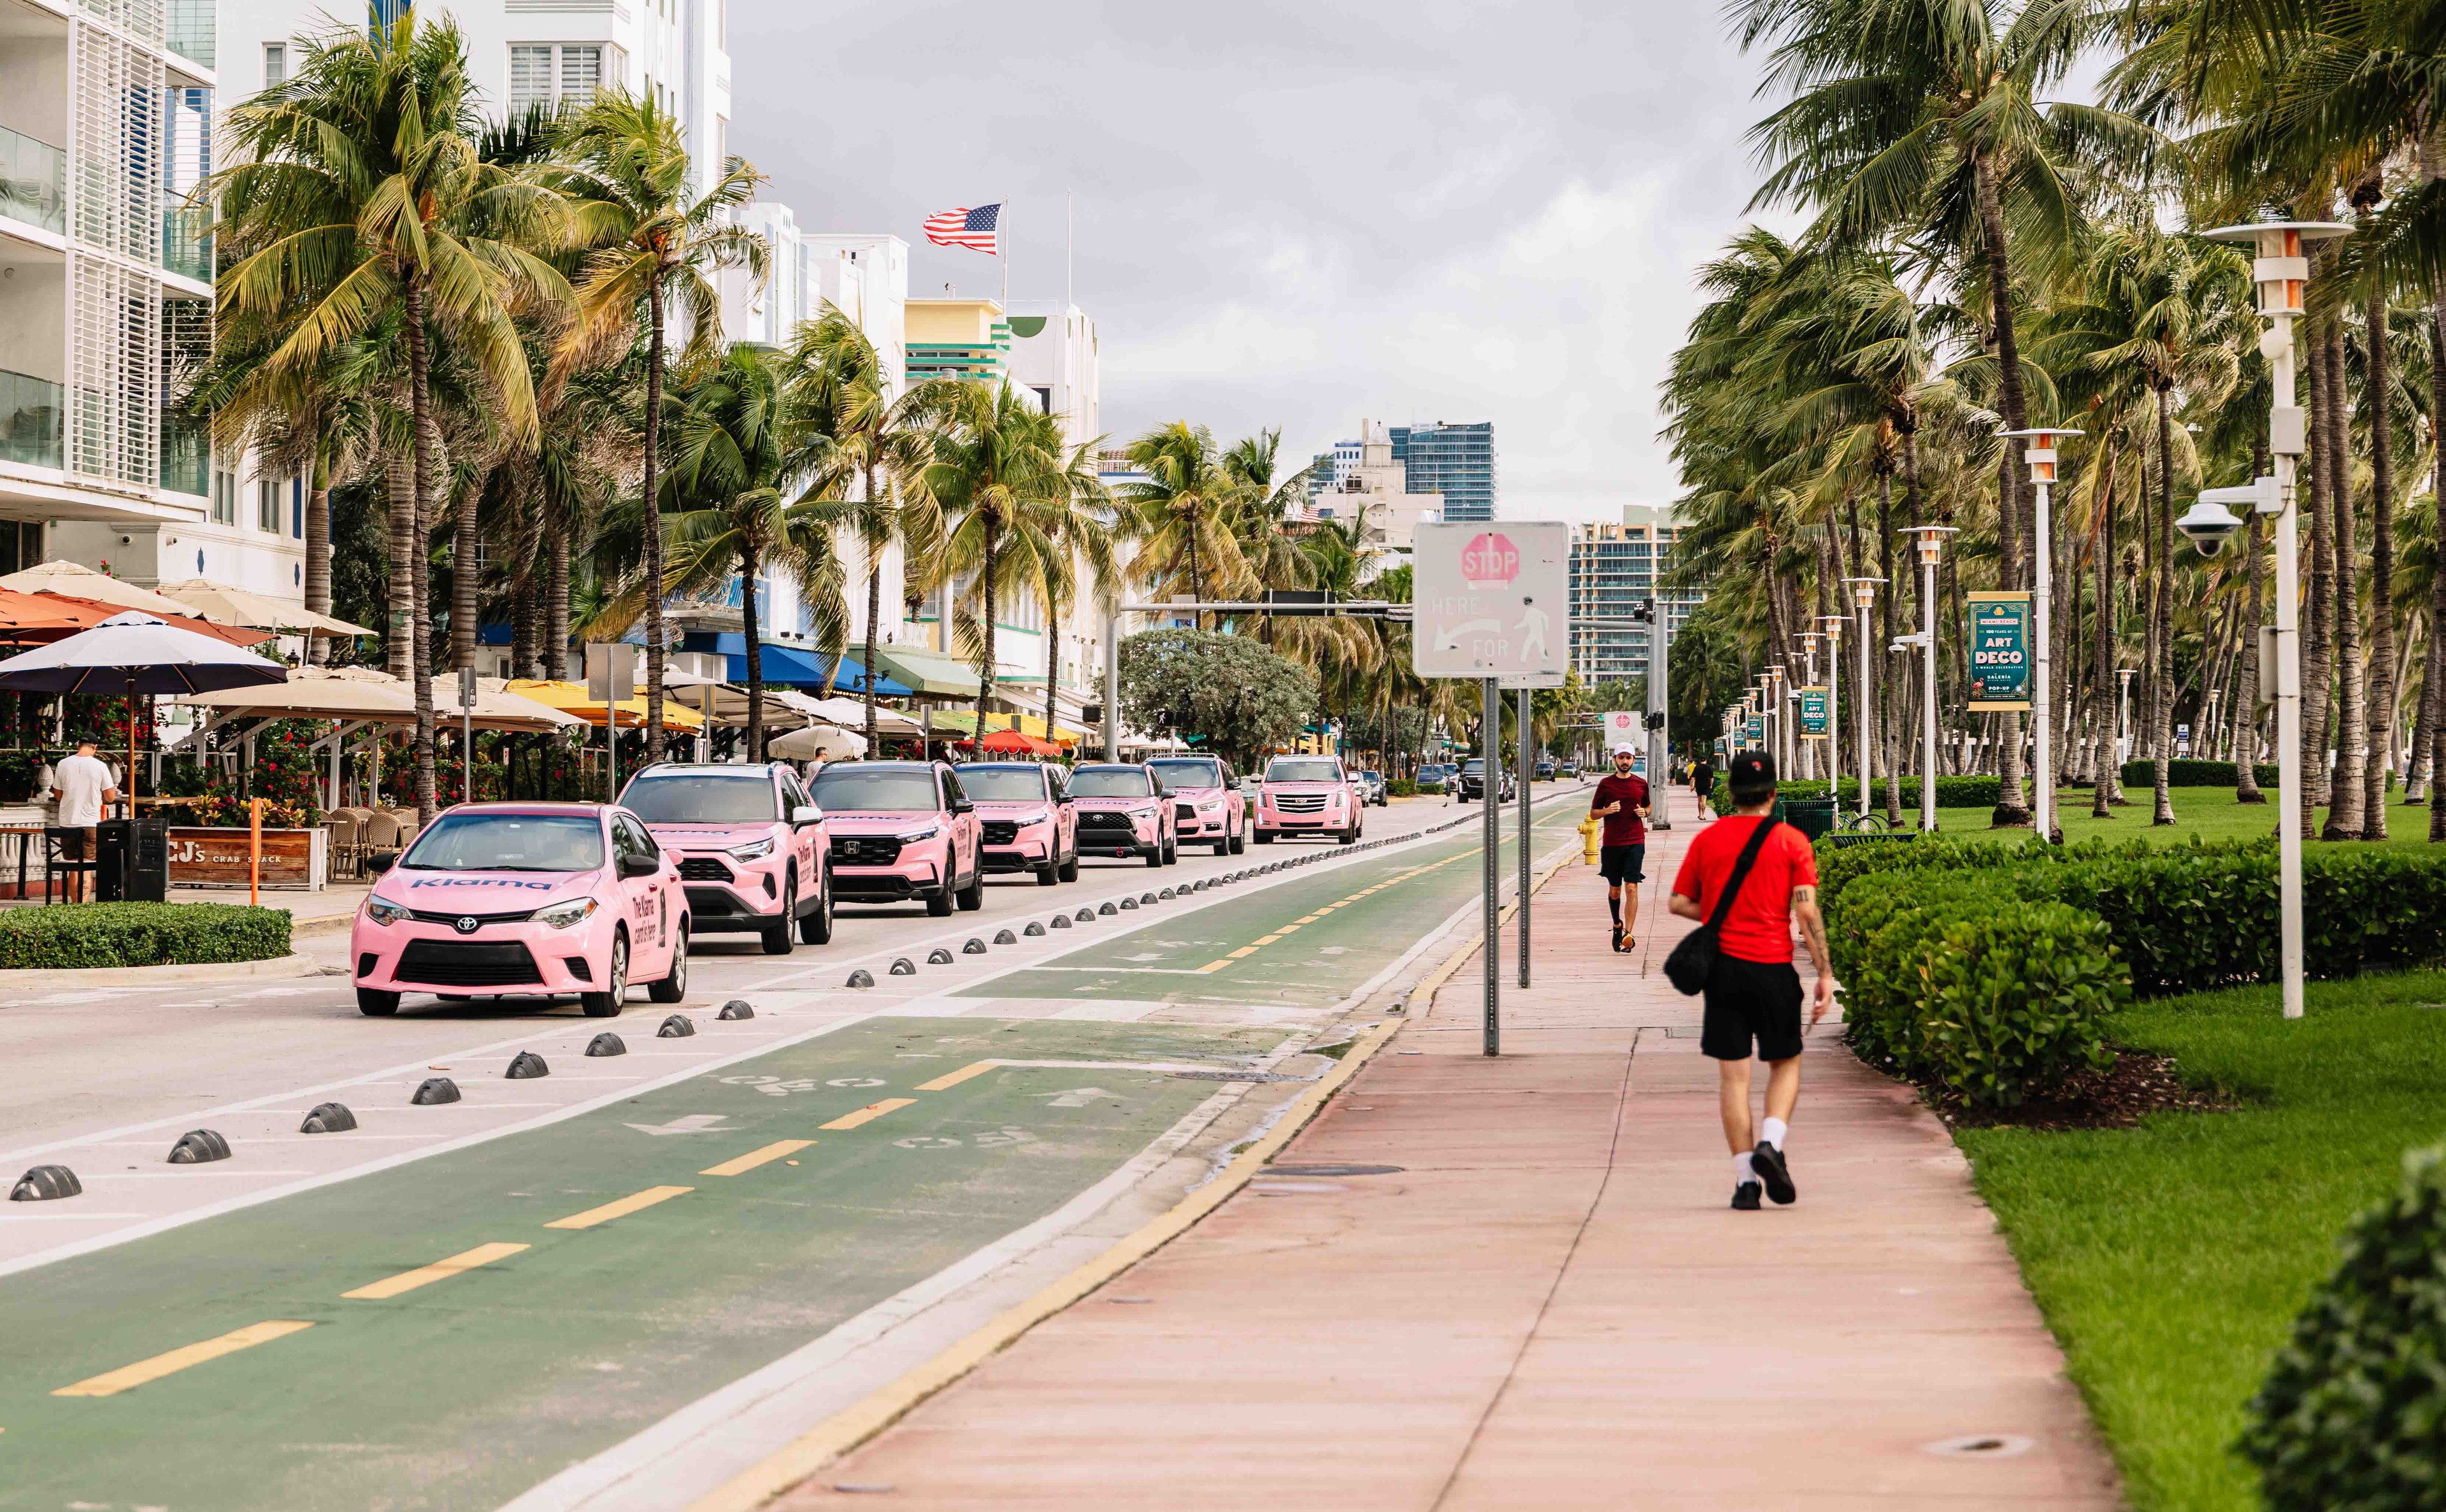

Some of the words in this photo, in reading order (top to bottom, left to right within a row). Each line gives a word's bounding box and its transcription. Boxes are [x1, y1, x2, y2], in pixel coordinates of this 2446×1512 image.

[1464, 550, 1517, 573] STOP
[1432, 596, 1478, 615] HERE
[1473, 638, 1508, 658] FOR
[1985, 638, 2013, 647] ART
[1975, 650, 2022, 664] DECO
[410, 878, 553, 890] Klarna
[633, 895, 642, 919] The
[640, 894, 654, 917] Klarna
